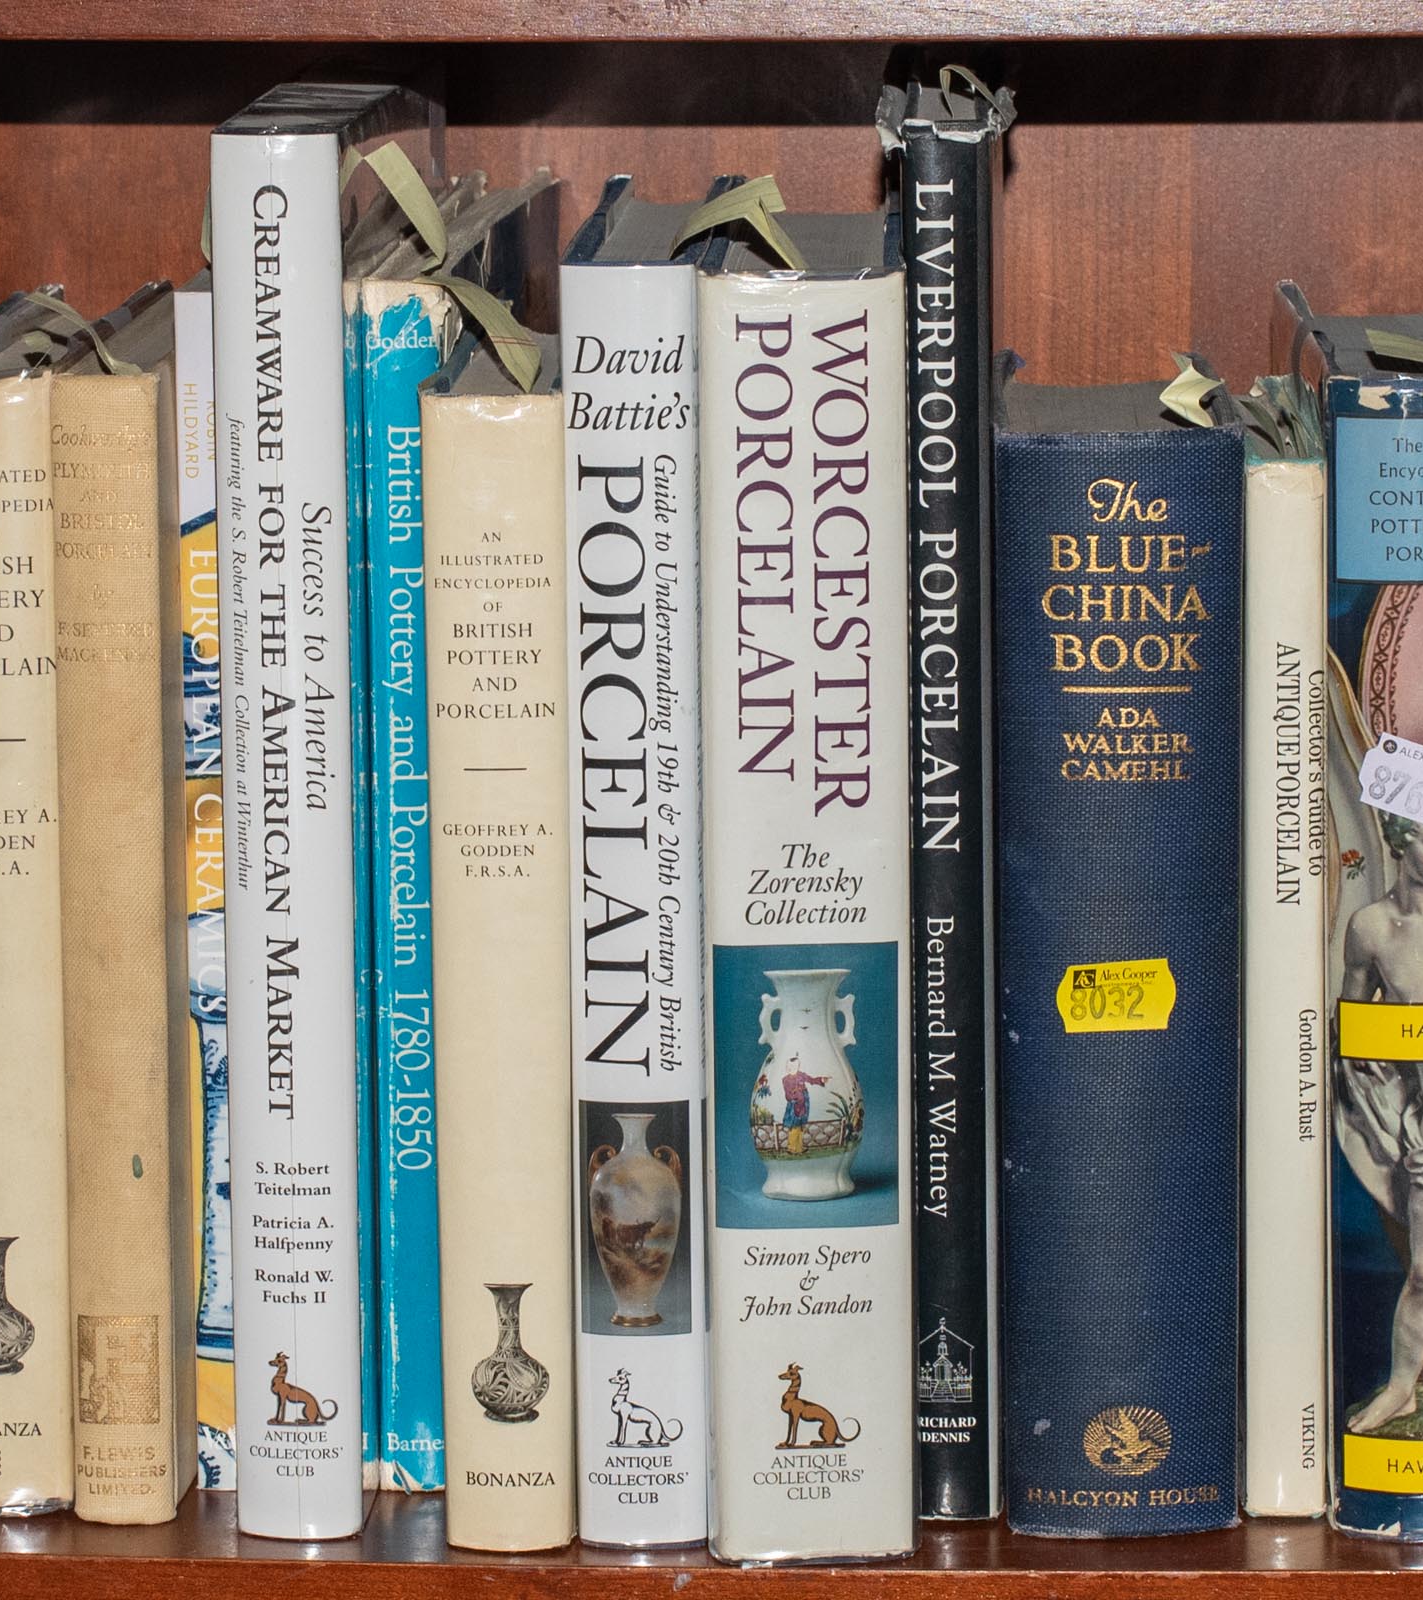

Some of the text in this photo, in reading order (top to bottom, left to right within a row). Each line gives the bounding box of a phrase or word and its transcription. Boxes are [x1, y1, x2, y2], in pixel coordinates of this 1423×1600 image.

[573, 336, 684, 374] David
[568, 392, 689, 430] Battie's
[1393, 437, 1421, 452] The
[915, 179, 960, 853] LIVERPOOL PORCELAIN
[1087, 479, 1168, 522] The
[440, 553, 543, 566] ILLUSTRATED
[735, 314, 795, 782] PORCELAIN
[812, 309, 869, 817] WORCESTER
[433, 577, 551, 590] ENCYCLOPEDIA
[1042, 585, 1212, 622] CHINA
[227, 414, 249, 891] featuring the S. Robert Teitelman Collection at Winterthur
[252, 185, 300, 1120] CREAMWARE FOR THE AMERICAN MARKET
[303, 502, 333, 810] Success to America
[1050, 635, 1202, 671] BOOK
[189, 549, 227, 1016] EUROPEAN CERAMICS
[578, 456, 651, 1077] PORCELAIN
[652, 453, 681, 1071] Guide to Understanding 19th & 20th Century British
[1273, 642, 1300, 906] ANTIQUE PORCELAIN
[382, 424, 431, 1171] British Pottery and Porcelain 1780-1850
[748, 870, 862, 900] Zorensky
[783, 843, 830, 869] The
[745, 900, 867, 926] Collection
[925, 916, 956, 1218] Bernard M. Watney
[1298, 1009, 1316, 1141] Gordon A. Rust
[745, 1245, 871, 1271] Simon Spero
[740, 1295, 872, 1322] John Sandon
[1302, 1403, 1315, 1469] VIKING
